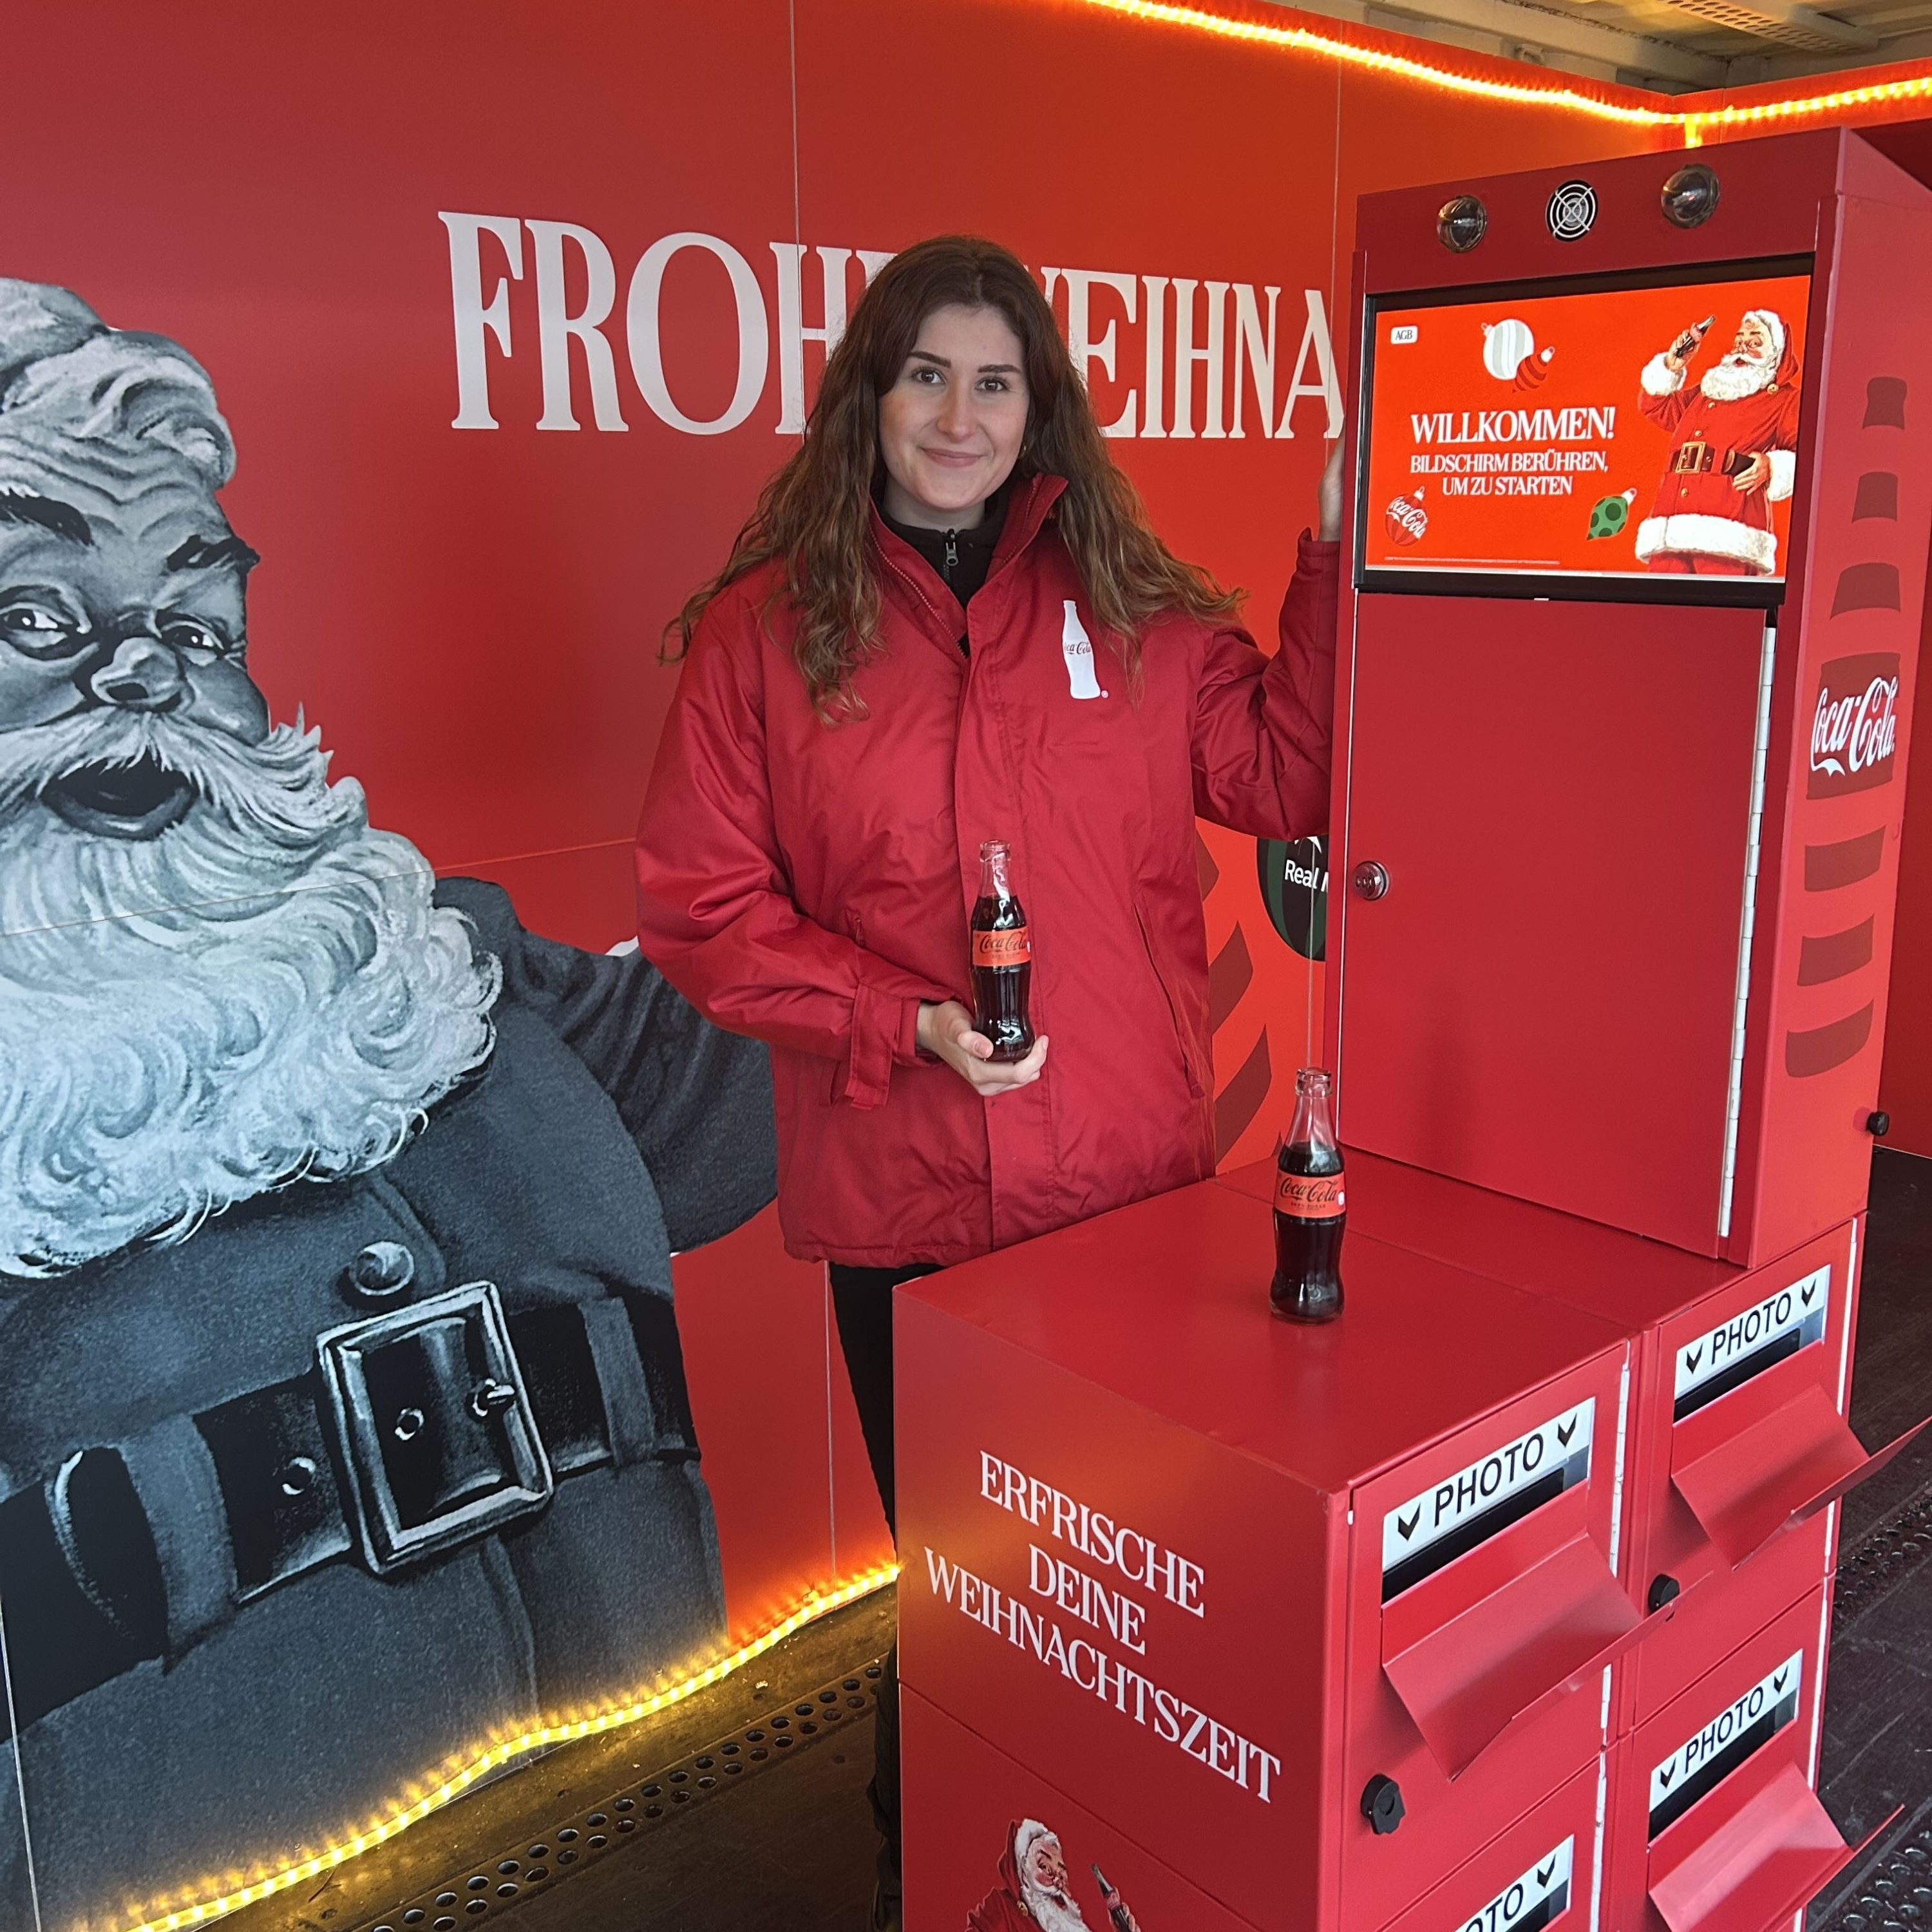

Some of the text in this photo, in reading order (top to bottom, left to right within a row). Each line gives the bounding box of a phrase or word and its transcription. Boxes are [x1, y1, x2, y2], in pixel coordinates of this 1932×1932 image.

[438, 211, 1344, 439] FROH EIHNA
[1395, 329, 1413, 340] AGB
[1410, 448, 1609, 473] BILDSCHIRM BERÜHREN,
[1411, 406, 1615, 444] WILLKOMMEN!
[1443, 475, 1573, 495] UM ZU STARTEN
[1810, 676, 1898, 777] Coca-Cola
[1285, 859, 1319, 889] Real
[980, 931, 1027, 953] Coca-Cola
[1280, 1177, 1338, 1202] Coca-Cola
[1711, 1292, 1792, 1365] PHOTO
[1434, 1433, 1544, 1528] PHOTO
[980, 1450, 1204, 1618] ERFRISCHE
[1028, 1543, 1146, 1655] DEINE
[923, 1546, 1281, 1803] WEIHNACHTSZEIT
[1685, 1686, 1764, 1774] PHOTO
